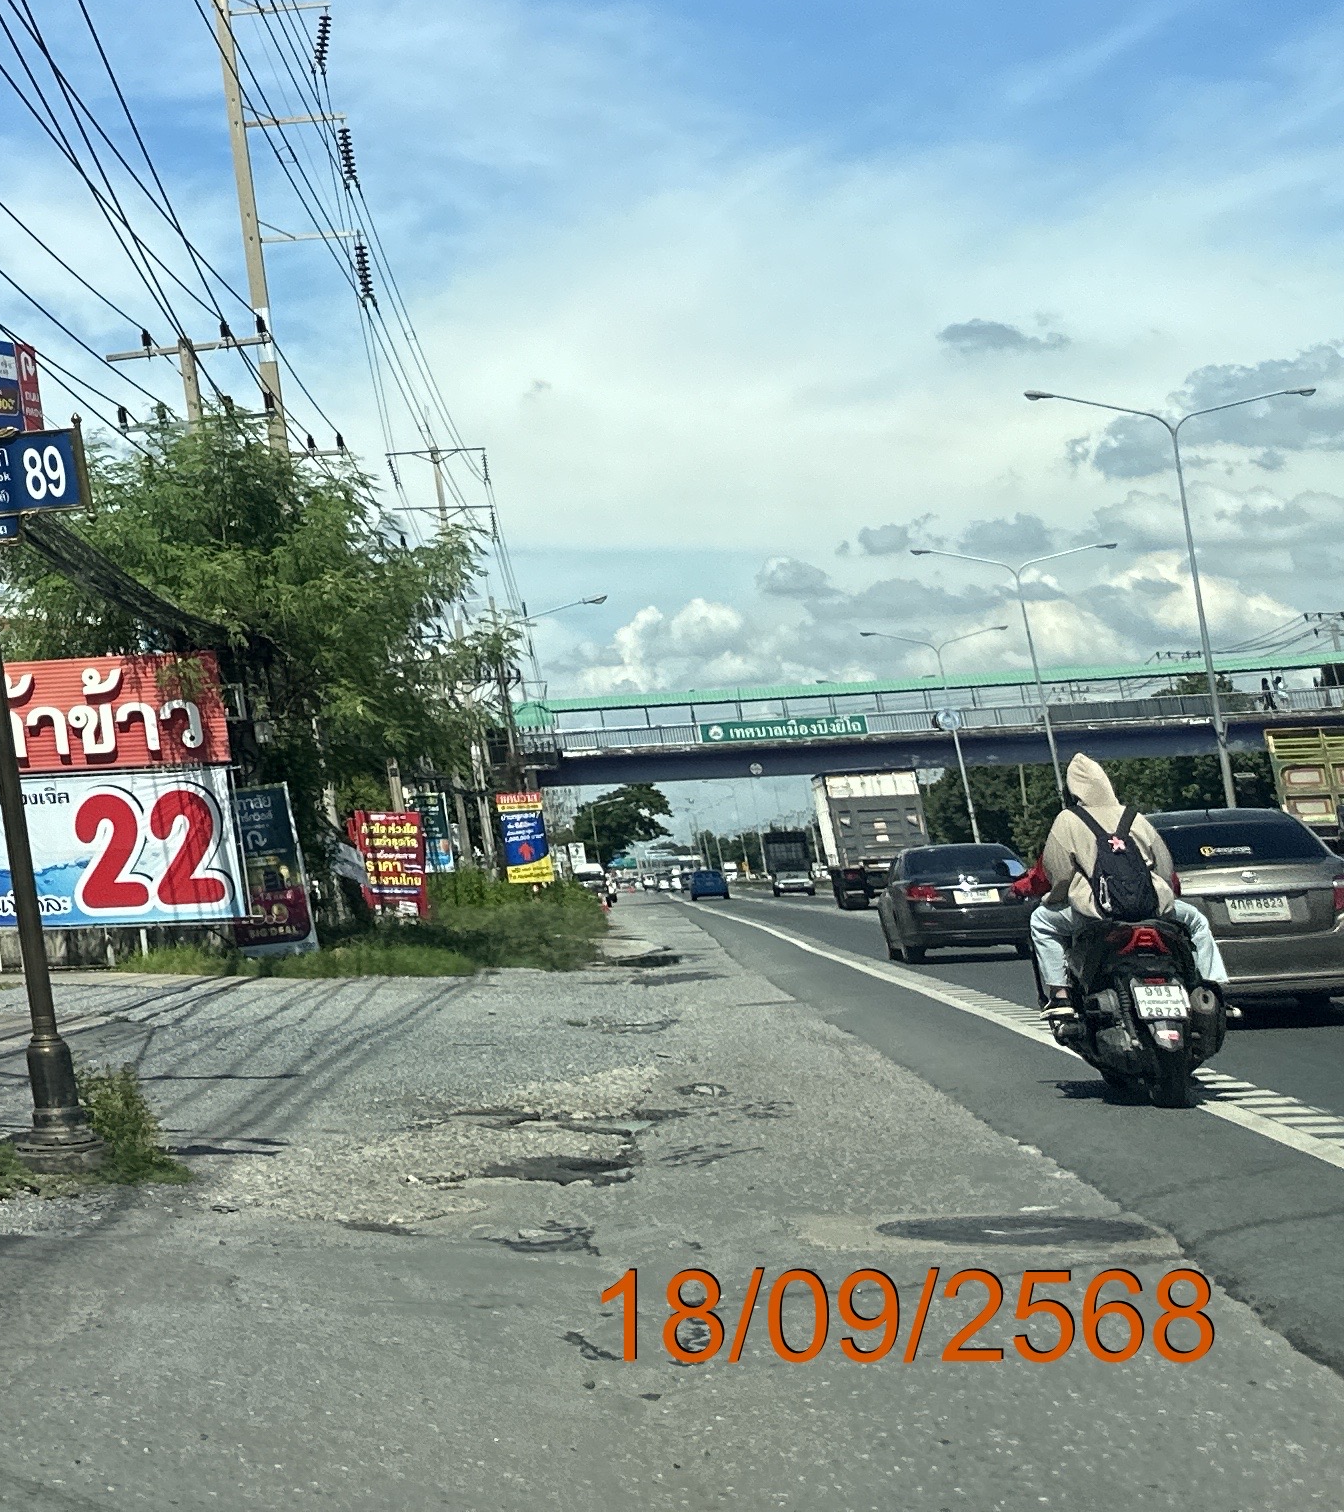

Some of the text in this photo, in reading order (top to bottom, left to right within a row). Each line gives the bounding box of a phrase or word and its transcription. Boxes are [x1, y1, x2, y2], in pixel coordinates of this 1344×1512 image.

[23, 445, 66, 500] 89
[729, 716, 861, 739] เทศบาลเมืองบึงยี่โถ
[75, 790, 225, 908] 22
